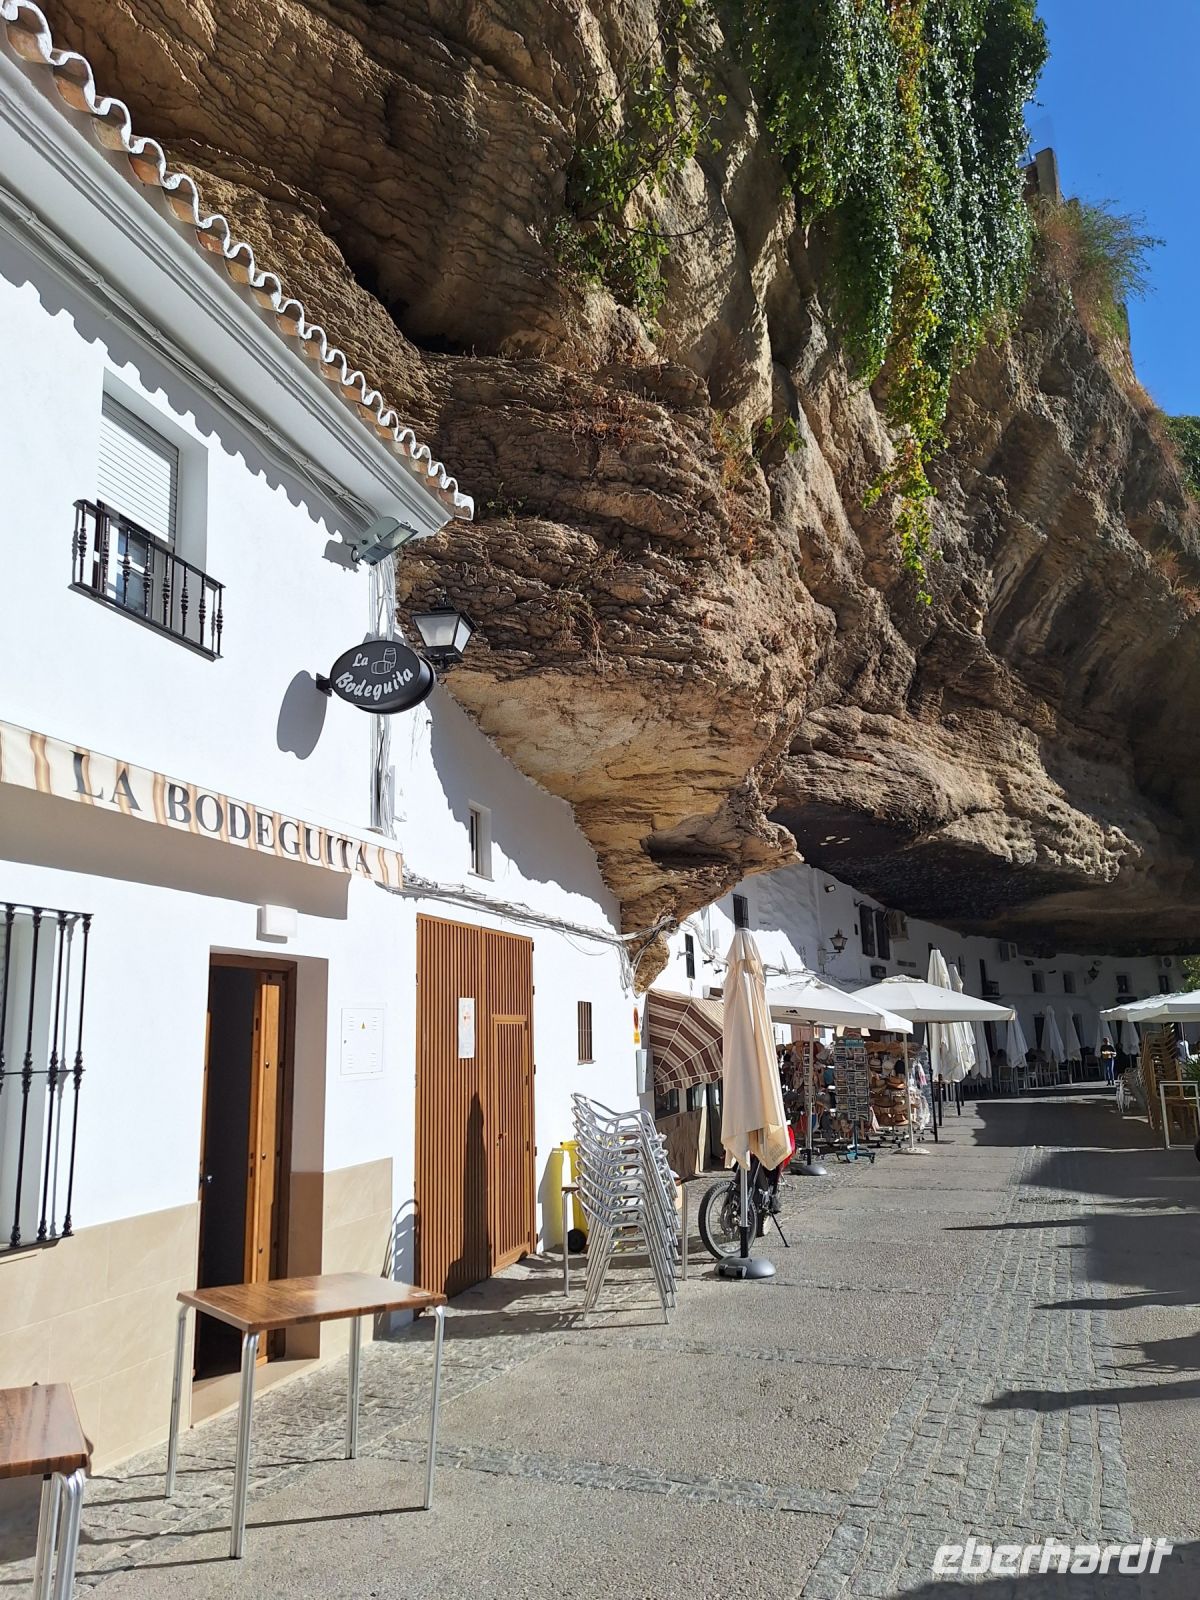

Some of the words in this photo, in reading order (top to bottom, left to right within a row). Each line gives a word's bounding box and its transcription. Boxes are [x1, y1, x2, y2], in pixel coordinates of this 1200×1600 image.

[352, 653, 369, 668] La
[335, 668, 414, 701] Bodeguita
[69, 749, 142, 812] LA
[167, 783, 372, 874] BODEGUITA
